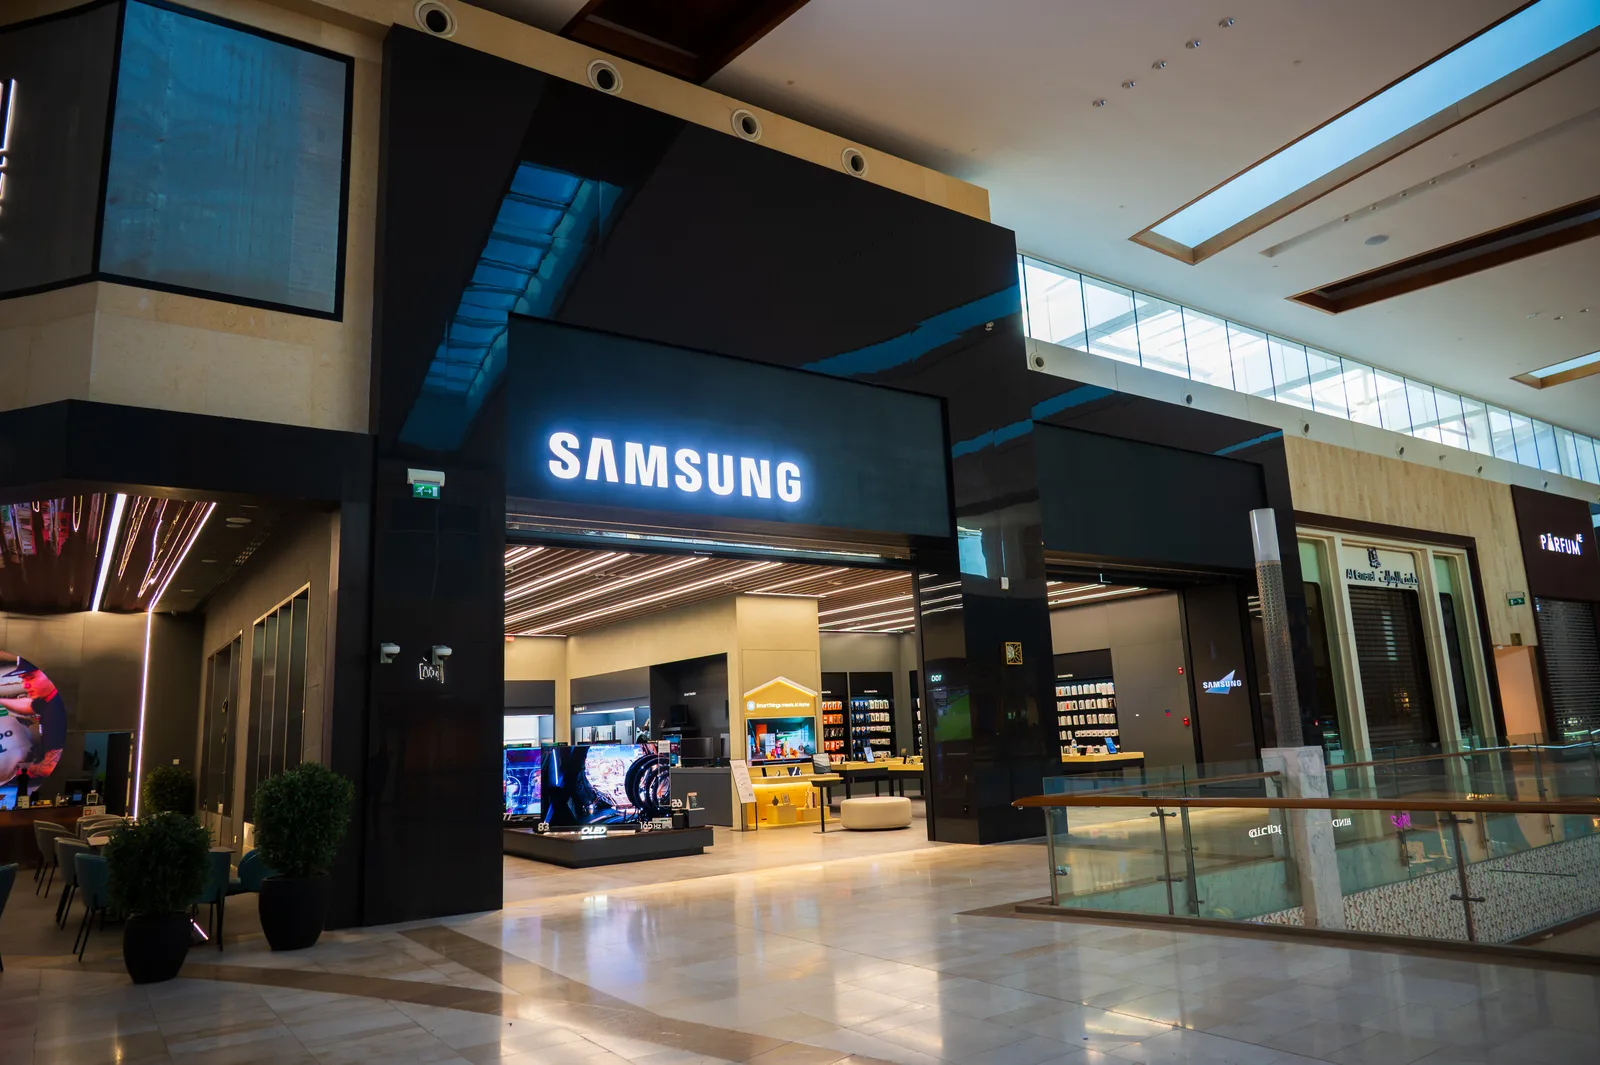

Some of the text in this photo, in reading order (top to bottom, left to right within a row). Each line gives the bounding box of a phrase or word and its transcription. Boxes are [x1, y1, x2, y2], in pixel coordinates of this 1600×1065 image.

[548, 431, 802, 503] SAMSUNG
[1202, 679, 1242, 689] SAMSUNG
[537, 822, 549, 832] 83
[581, 826, 607, 835] OLED
[639, 821, 653, 830] 165
